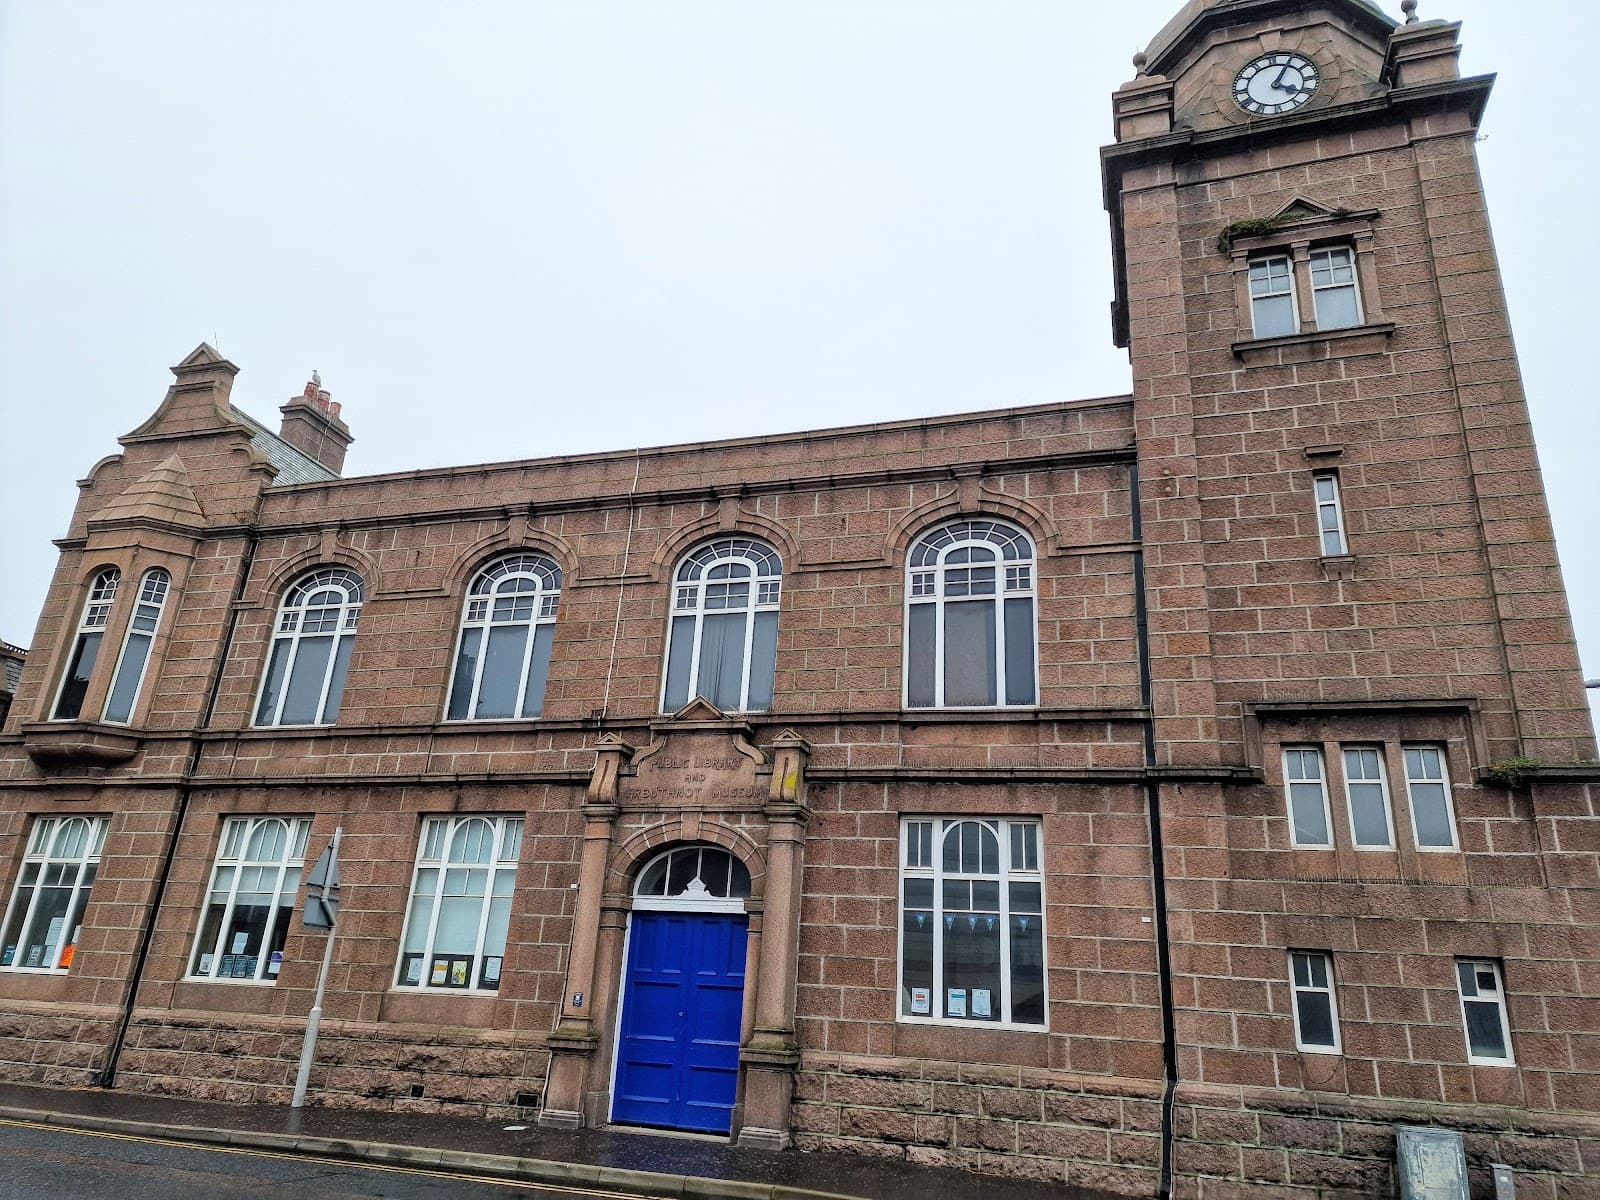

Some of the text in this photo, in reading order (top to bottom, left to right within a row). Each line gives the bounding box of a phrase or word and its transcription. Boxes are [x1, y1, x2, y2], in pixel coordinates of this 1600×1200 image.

[650, 757, 743, 770] PUBLIC LIBRARY
[684, 773, 705, 784] AND
[626, 786, 763, 801] ARBUTHNOT MUSEUM
